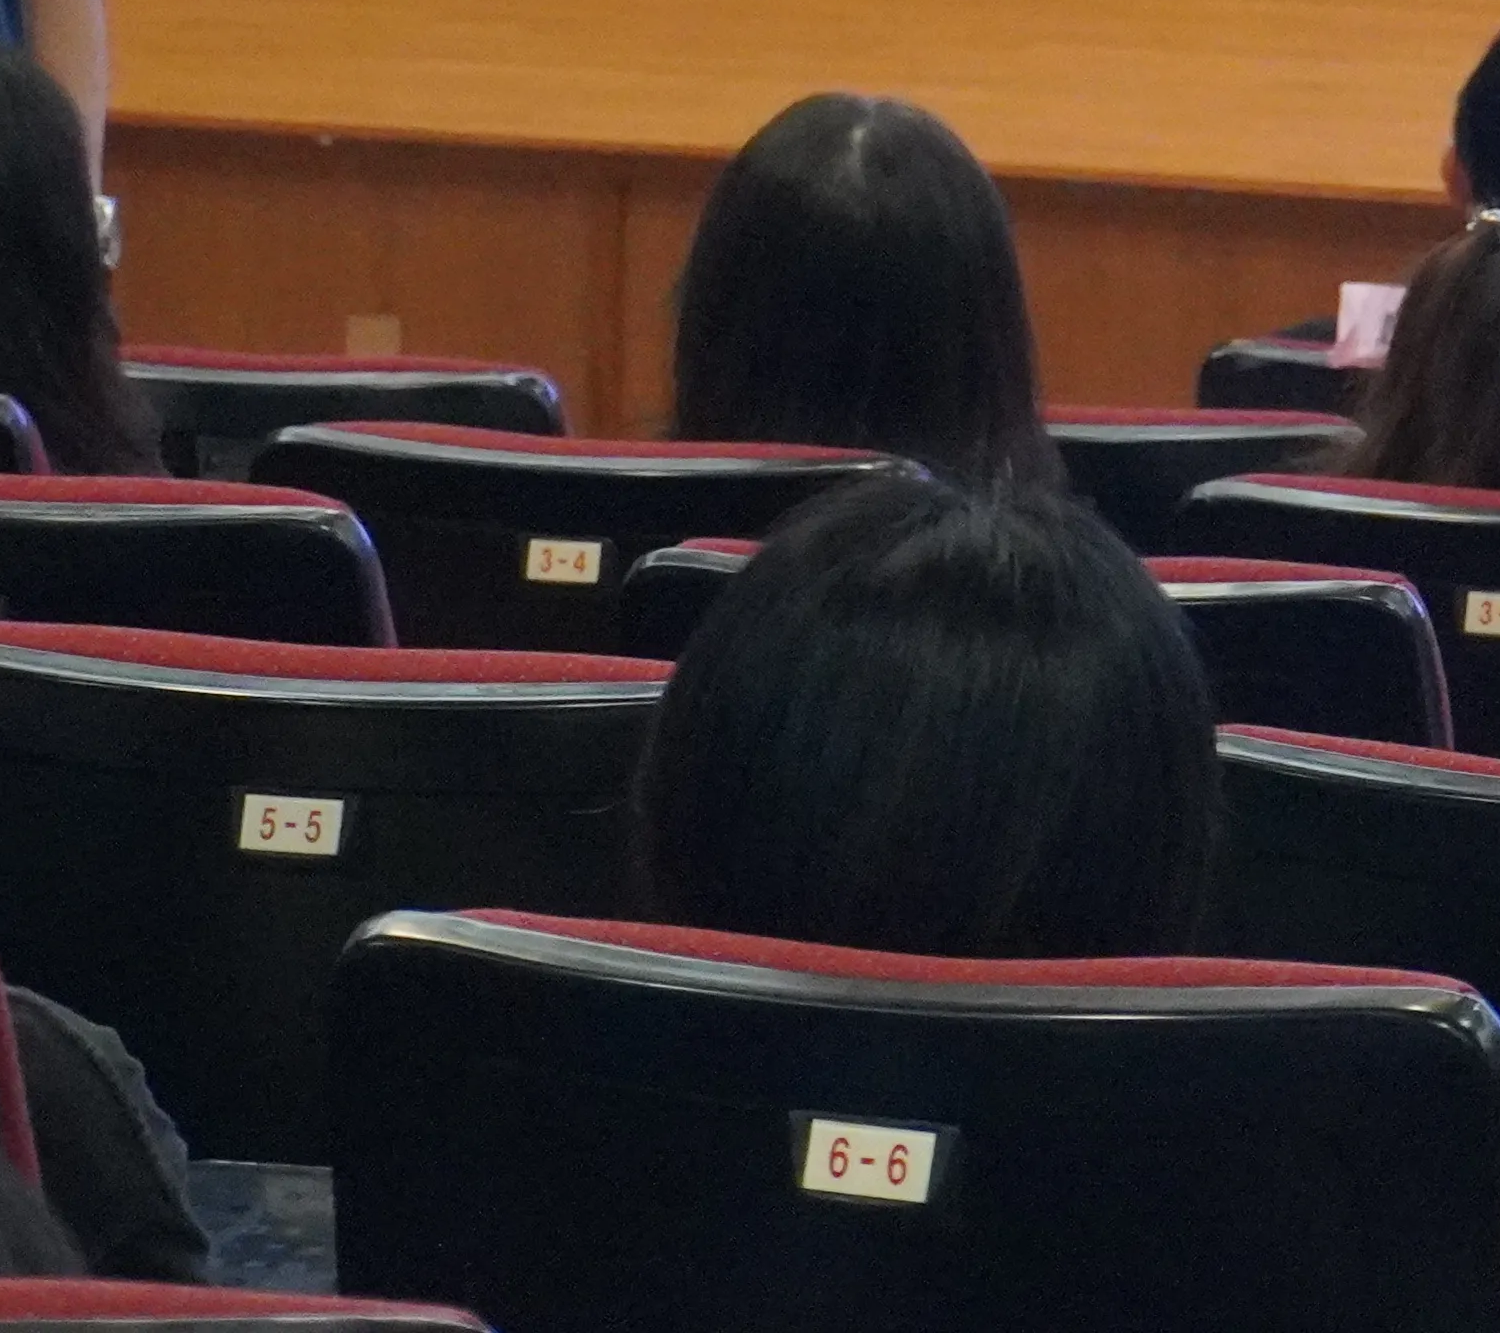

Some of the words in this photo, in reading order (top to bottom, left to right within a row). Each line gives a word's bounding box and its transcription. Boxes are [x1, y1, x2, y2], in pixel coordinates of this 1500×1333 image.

[540, 546, 587, 574] 3-4
[260, 807, 323, 843] 5-5
[829, 1137, 909, 1186] 6-6
